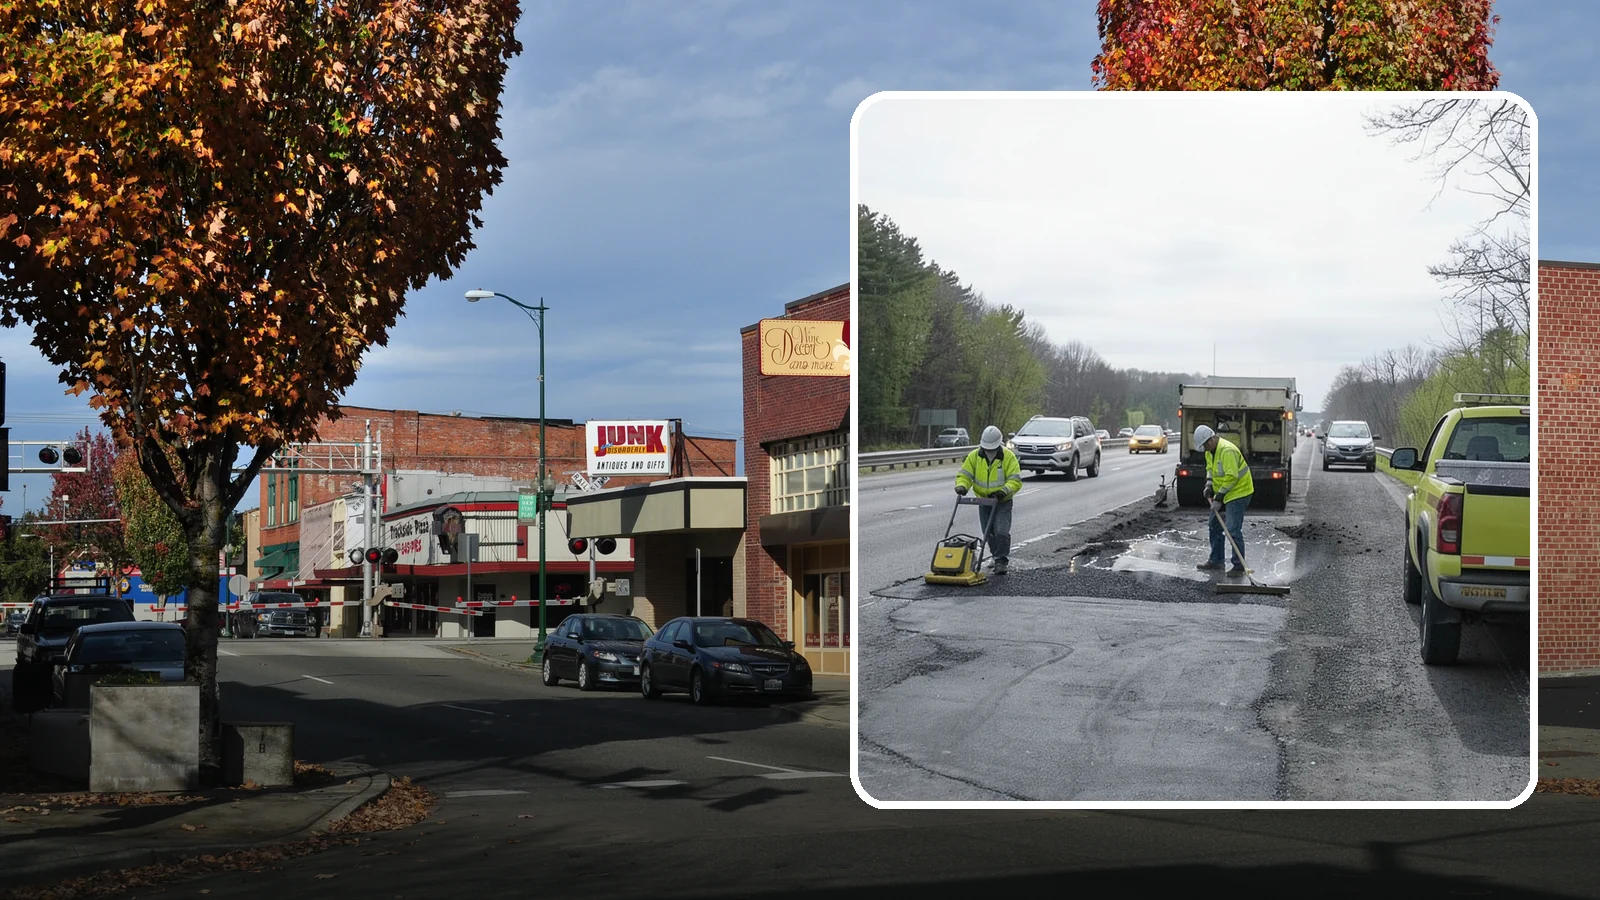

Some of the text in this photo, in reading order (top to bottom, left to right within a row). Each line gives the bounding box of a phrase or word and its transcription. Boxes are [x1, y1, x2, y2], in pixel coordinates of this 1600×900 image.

[595, 425, 665, 457] JUNK
[607, 446, 645, 454] DISORDERLY
[597, 460, 665, 470] ANTIQUES AND GIFTS
[390, 519, 429, 540] Trackside Pizza
